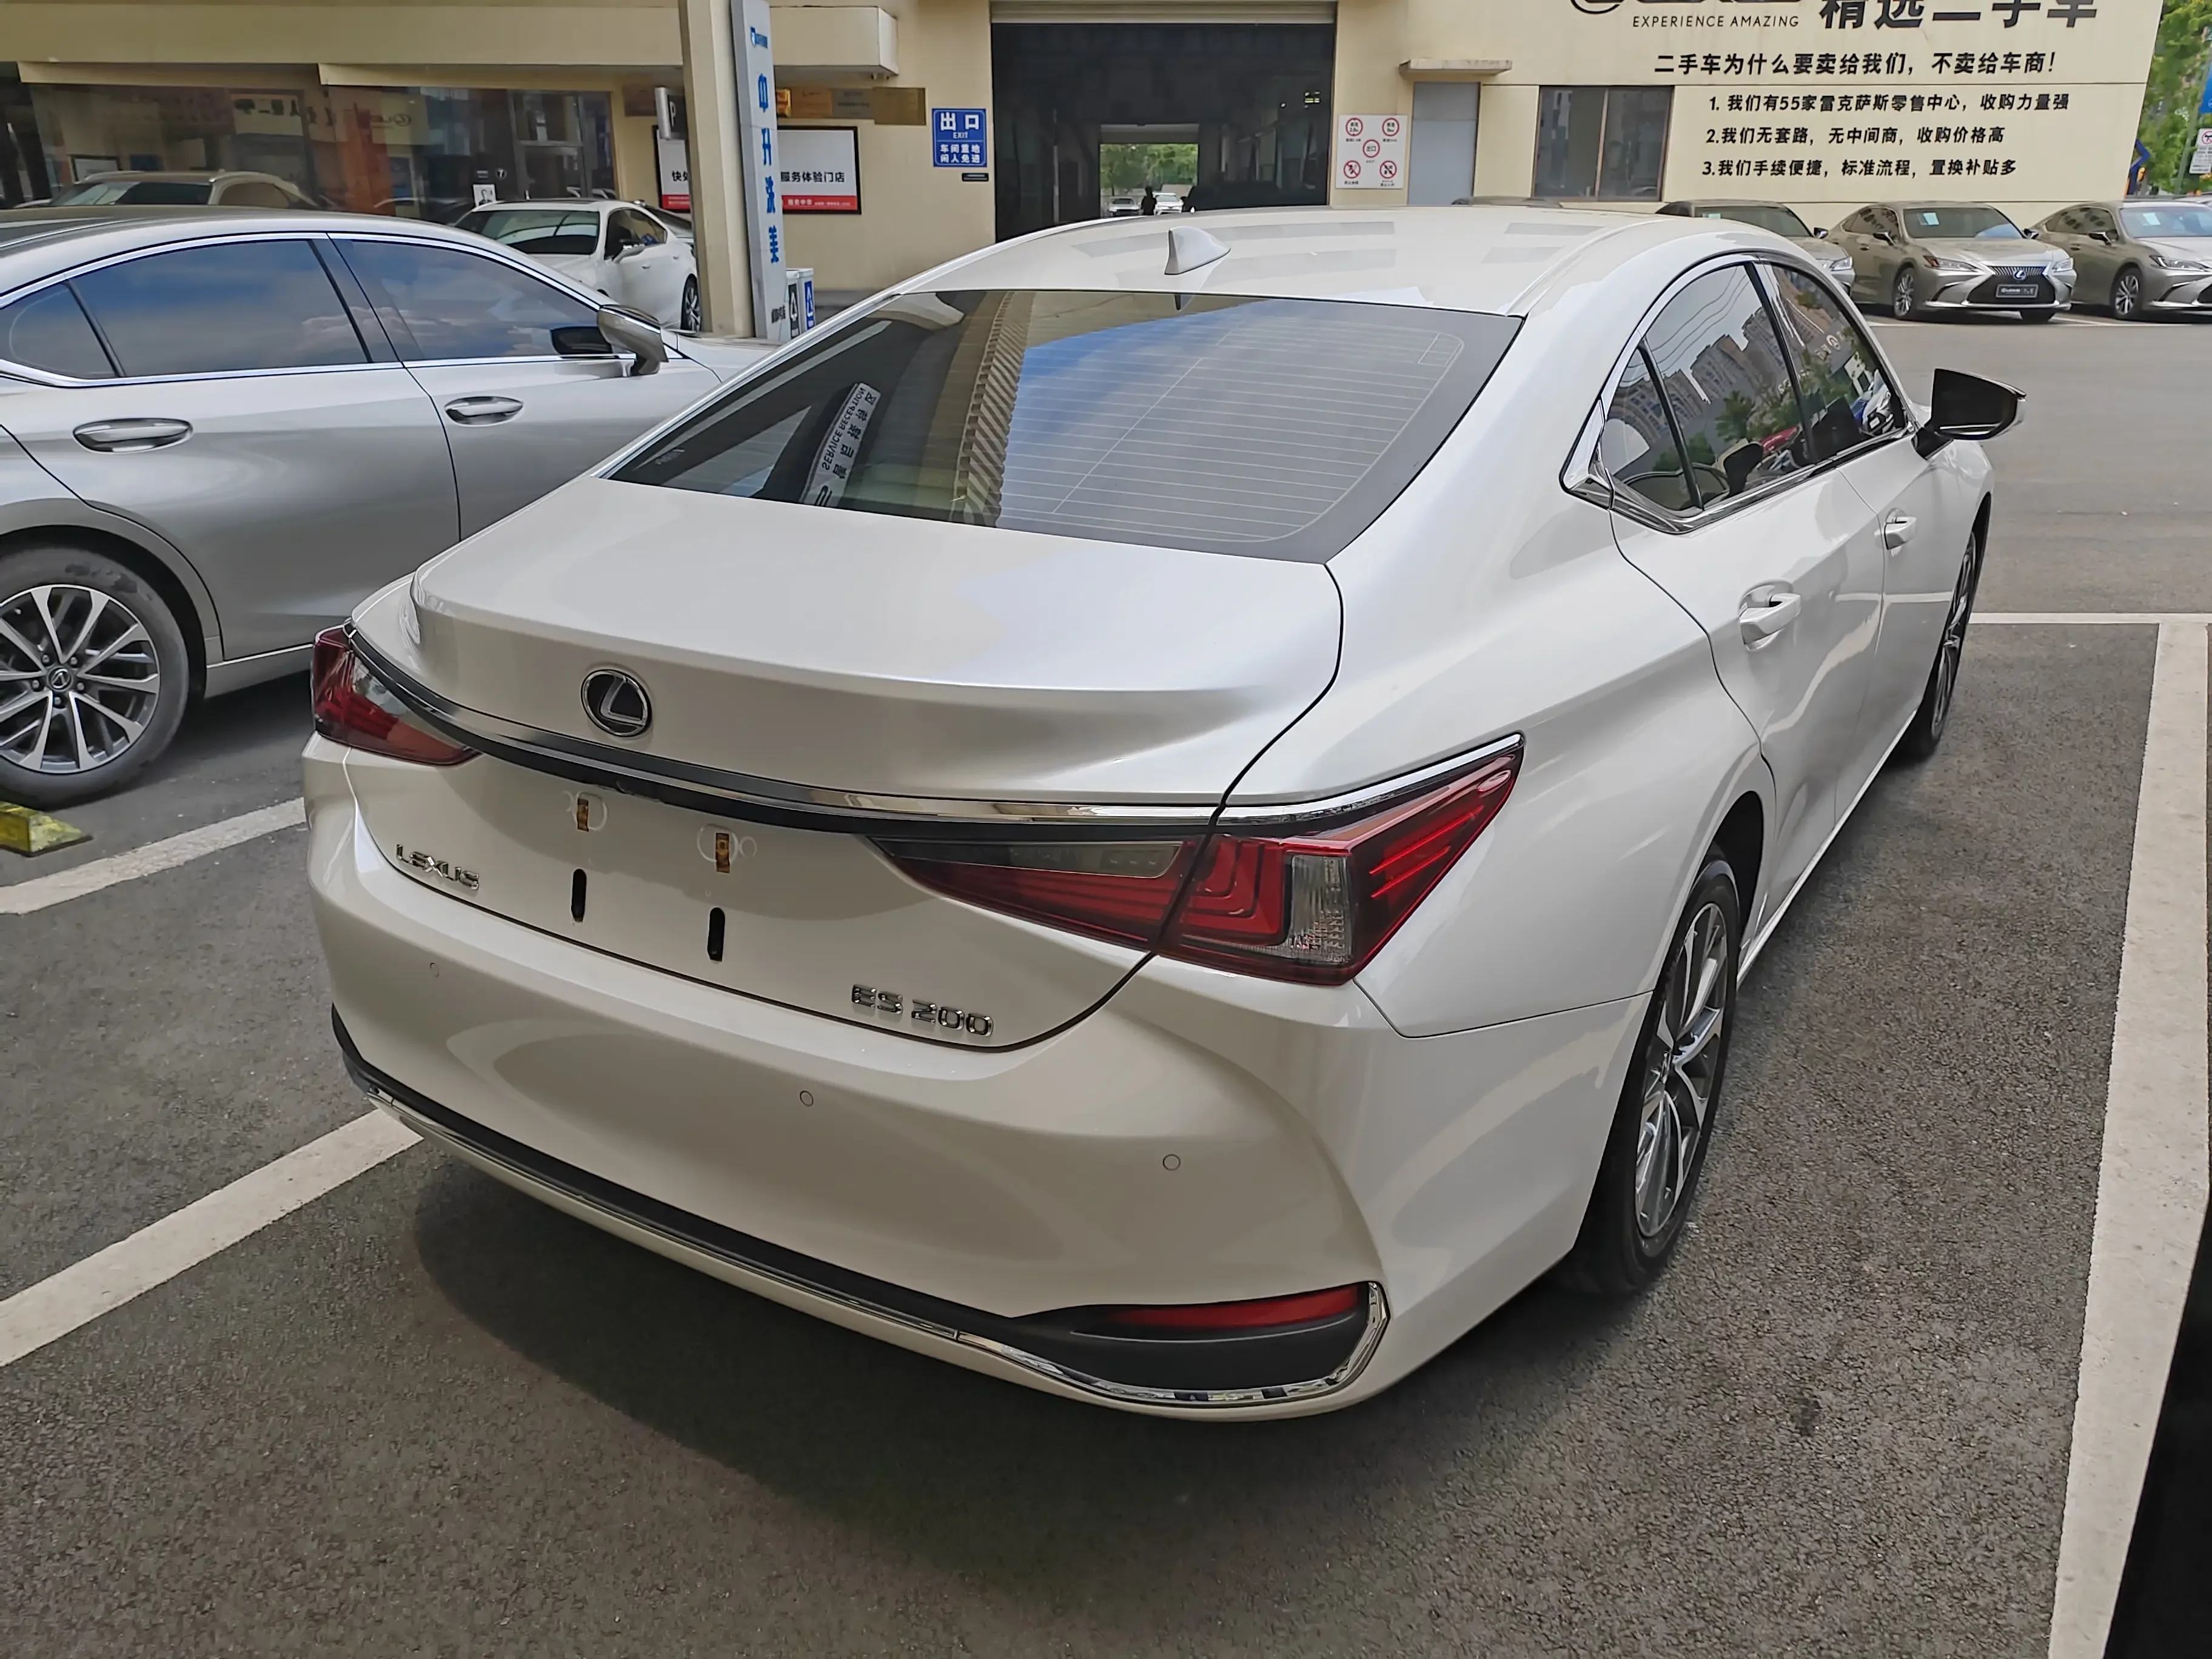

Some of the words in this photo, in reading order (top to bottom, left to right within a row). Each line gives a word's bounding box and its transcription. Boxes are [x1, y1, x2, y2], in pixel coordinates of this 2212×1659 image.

[1632, 15, 1724, 28] EXPERIENCE
[1730, 15, 1799, 27] AMAZING
[940, 112, 980, 131] 出口
[940, 144, 980, 153] 车间重地
[780, 172, 845, 183] 服务体验门店
[396, 844, 480, 891] LEXUS
[851, 984, 904, 1014] ES
[911, 999, 994, 1037] 200
